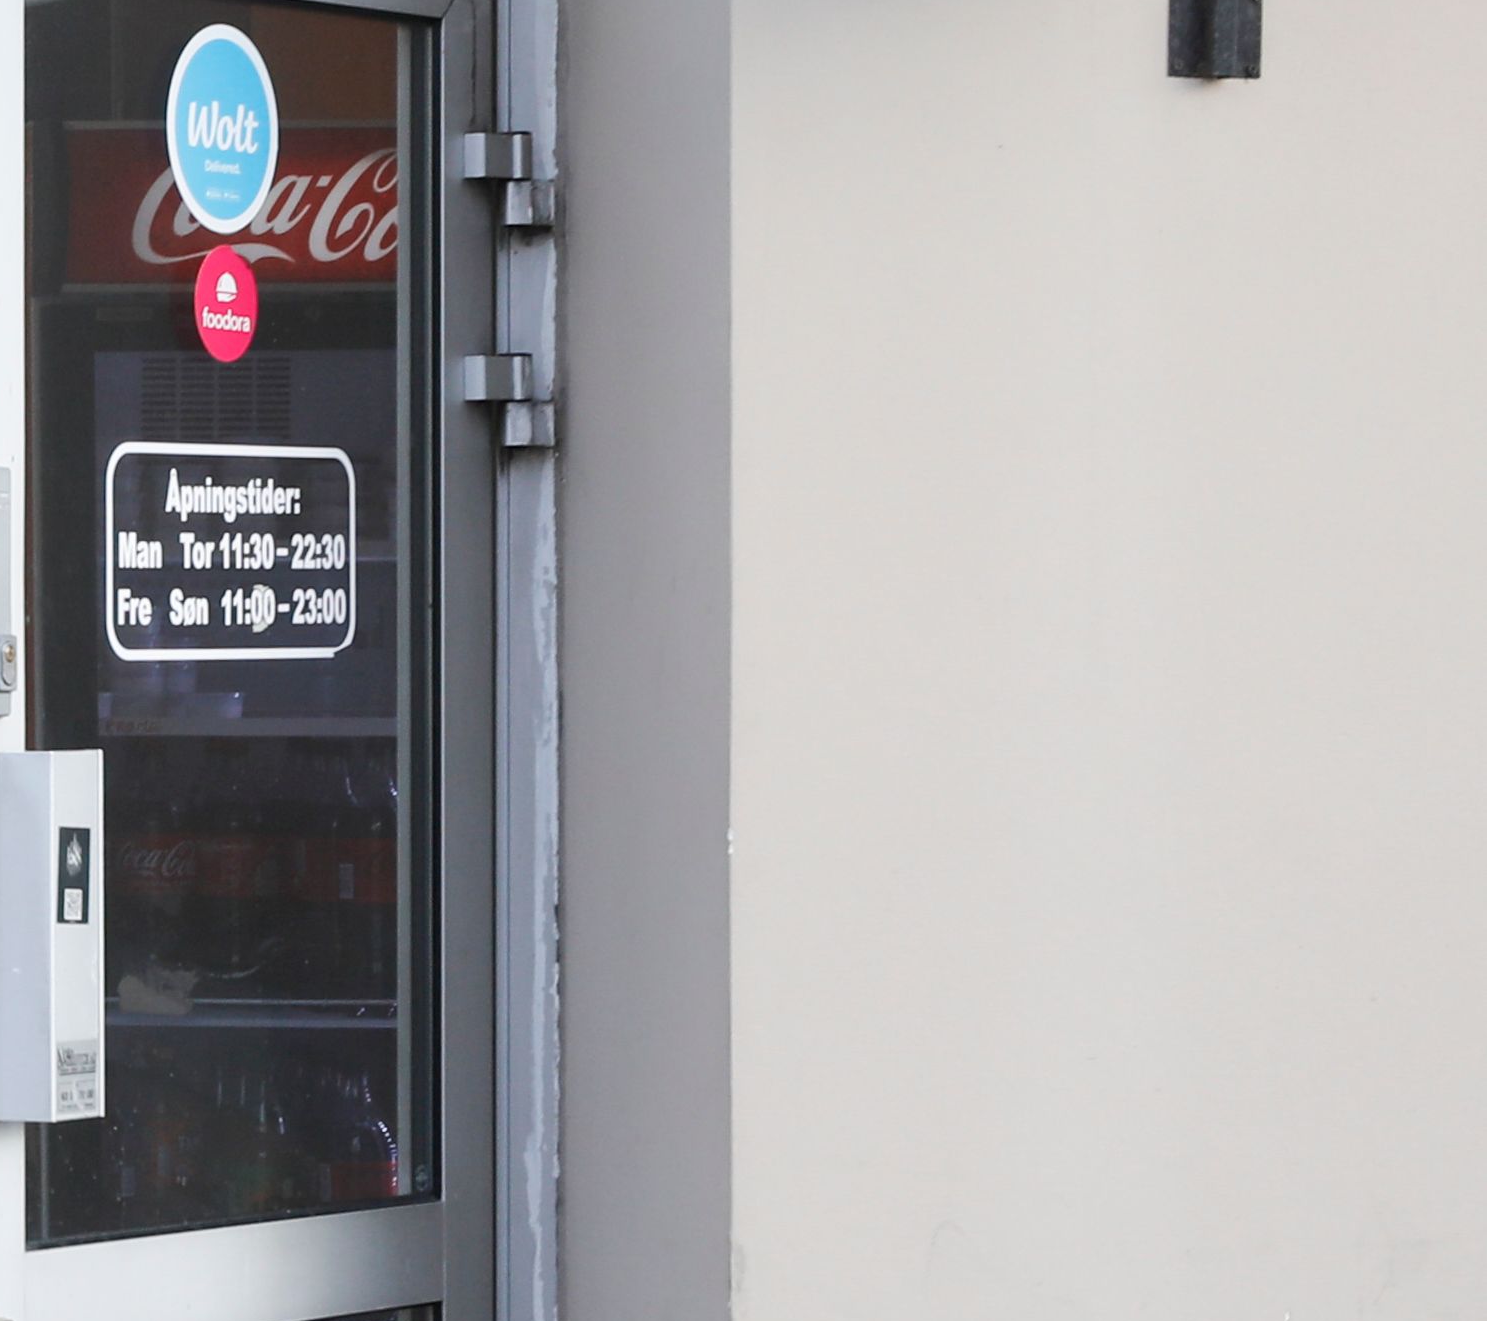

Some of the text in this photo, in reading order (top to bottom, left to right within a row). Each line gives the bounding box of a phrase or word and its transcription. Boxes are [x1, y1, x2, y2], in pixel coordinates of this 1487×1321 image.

[186, 100, 260, 156] Wolt
[201, 306, 251, 334] foodora
[117, 531, 163, 569] Man
[179, 532, 215, 569] Tor
[116, 588, 153, 626] Fre
[169, 588, 210, 627] Søn
